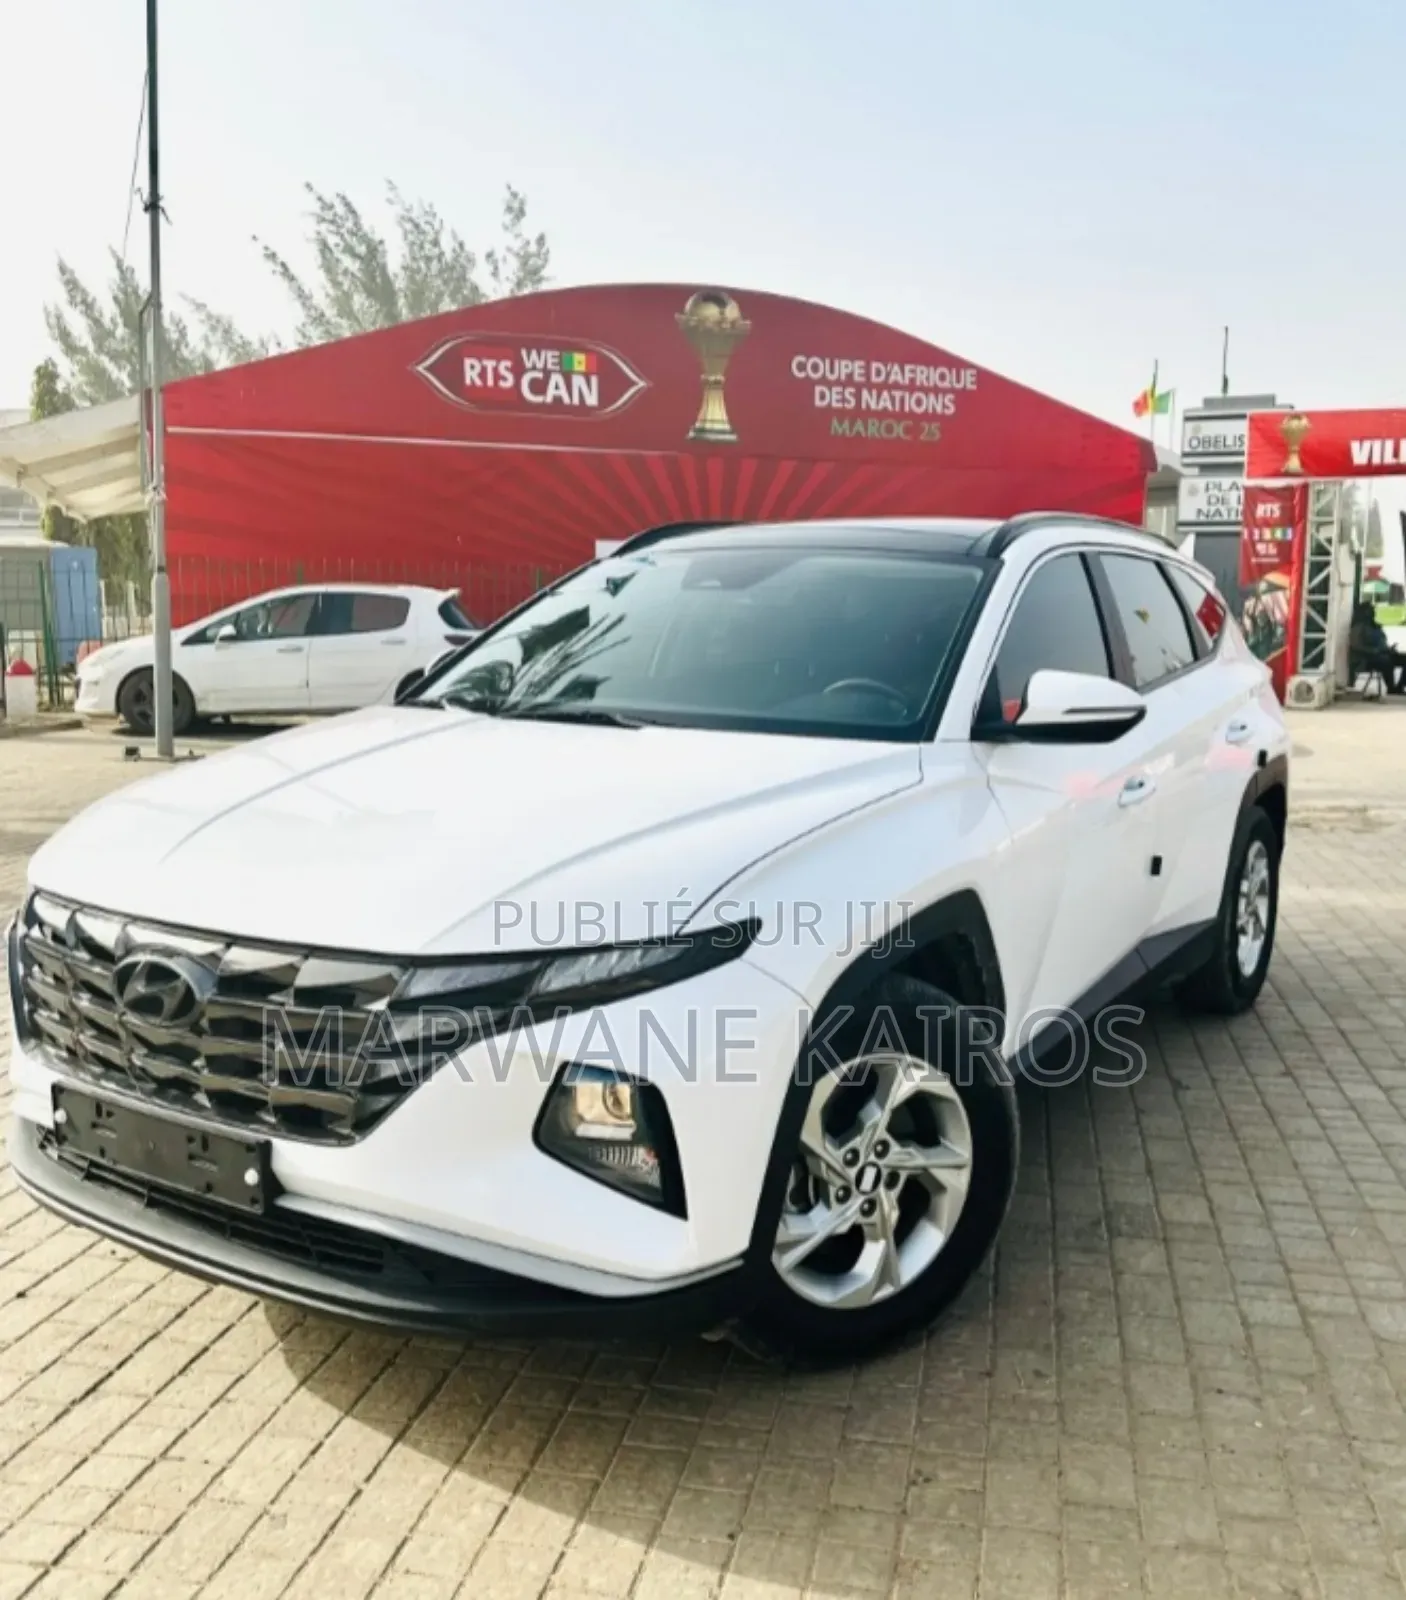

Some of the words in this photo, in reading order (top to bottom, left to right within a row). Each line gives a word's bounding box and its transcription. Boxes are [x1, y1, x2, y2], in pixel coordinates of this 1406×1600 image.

[463, 356, 515, 388] RTS
[521, 348, 560, 370] WE
[791, 355, 866, 382] COUPE
[870, 362, 977, 390] D'AFRIQUE
[520, 371, 599, 407] CAN
[814, 386, 856, 408] DES
[861, 388, 956, 415] NATIONS
[830, 417, 913, 440] MAROC
[919, 421, 941, 441] 25
[1196, 507, 1243, 520] NATI
[1256, 502, 1281, 518] RTS
